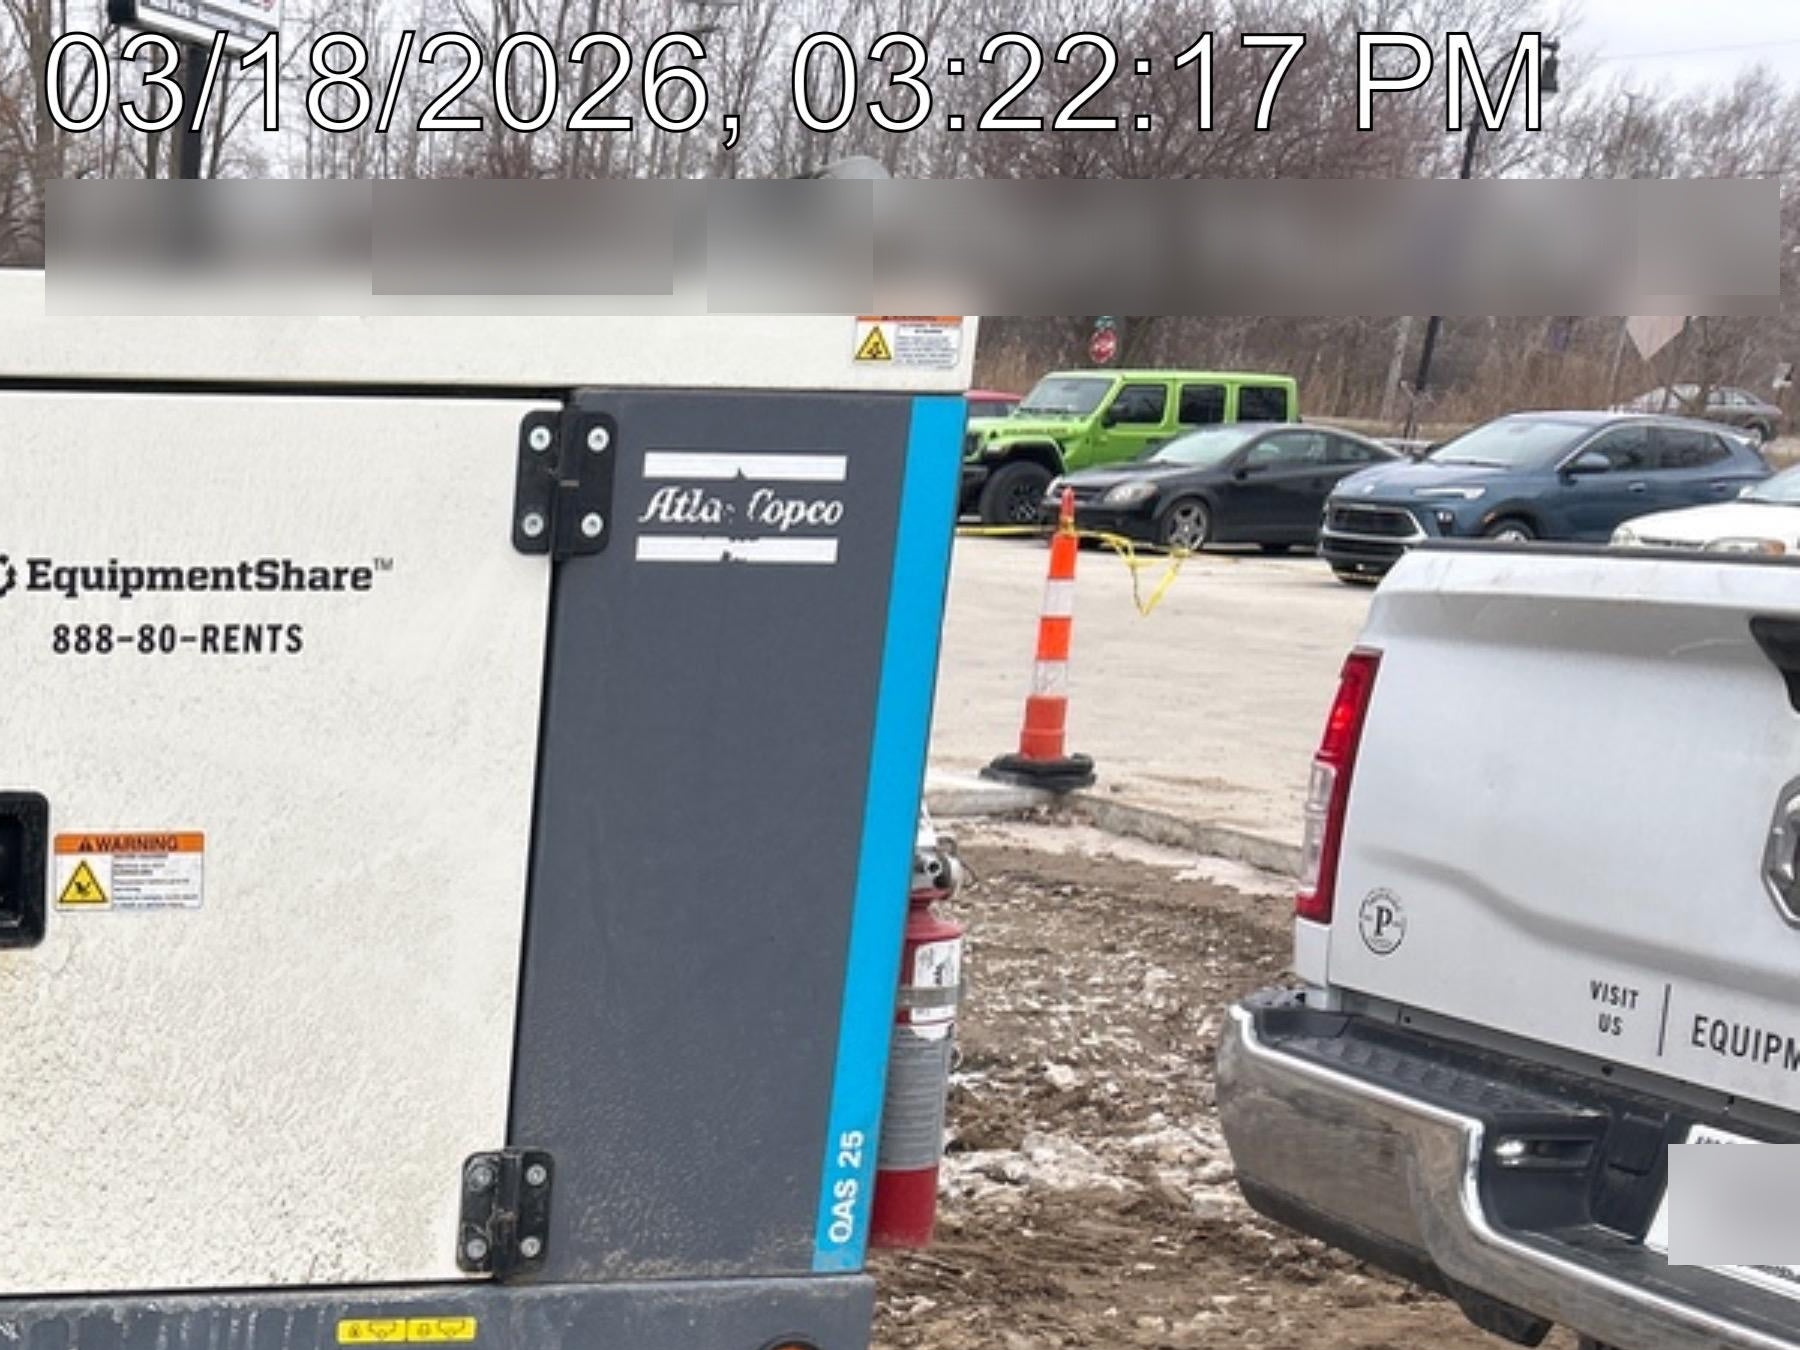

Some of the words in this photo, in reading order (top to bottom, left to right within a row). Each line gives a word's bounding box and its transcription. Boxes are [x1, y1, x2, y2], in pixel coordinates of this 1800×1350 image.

[52, 623, 305, 655] 888-80-RENTS
[96, 834, 178, 851] WARNING
[1590, 980, 1639, 1009] VISIT
[1599, 1012, 1623, 1036] US
[838, 1130, 864, 1168] 25
